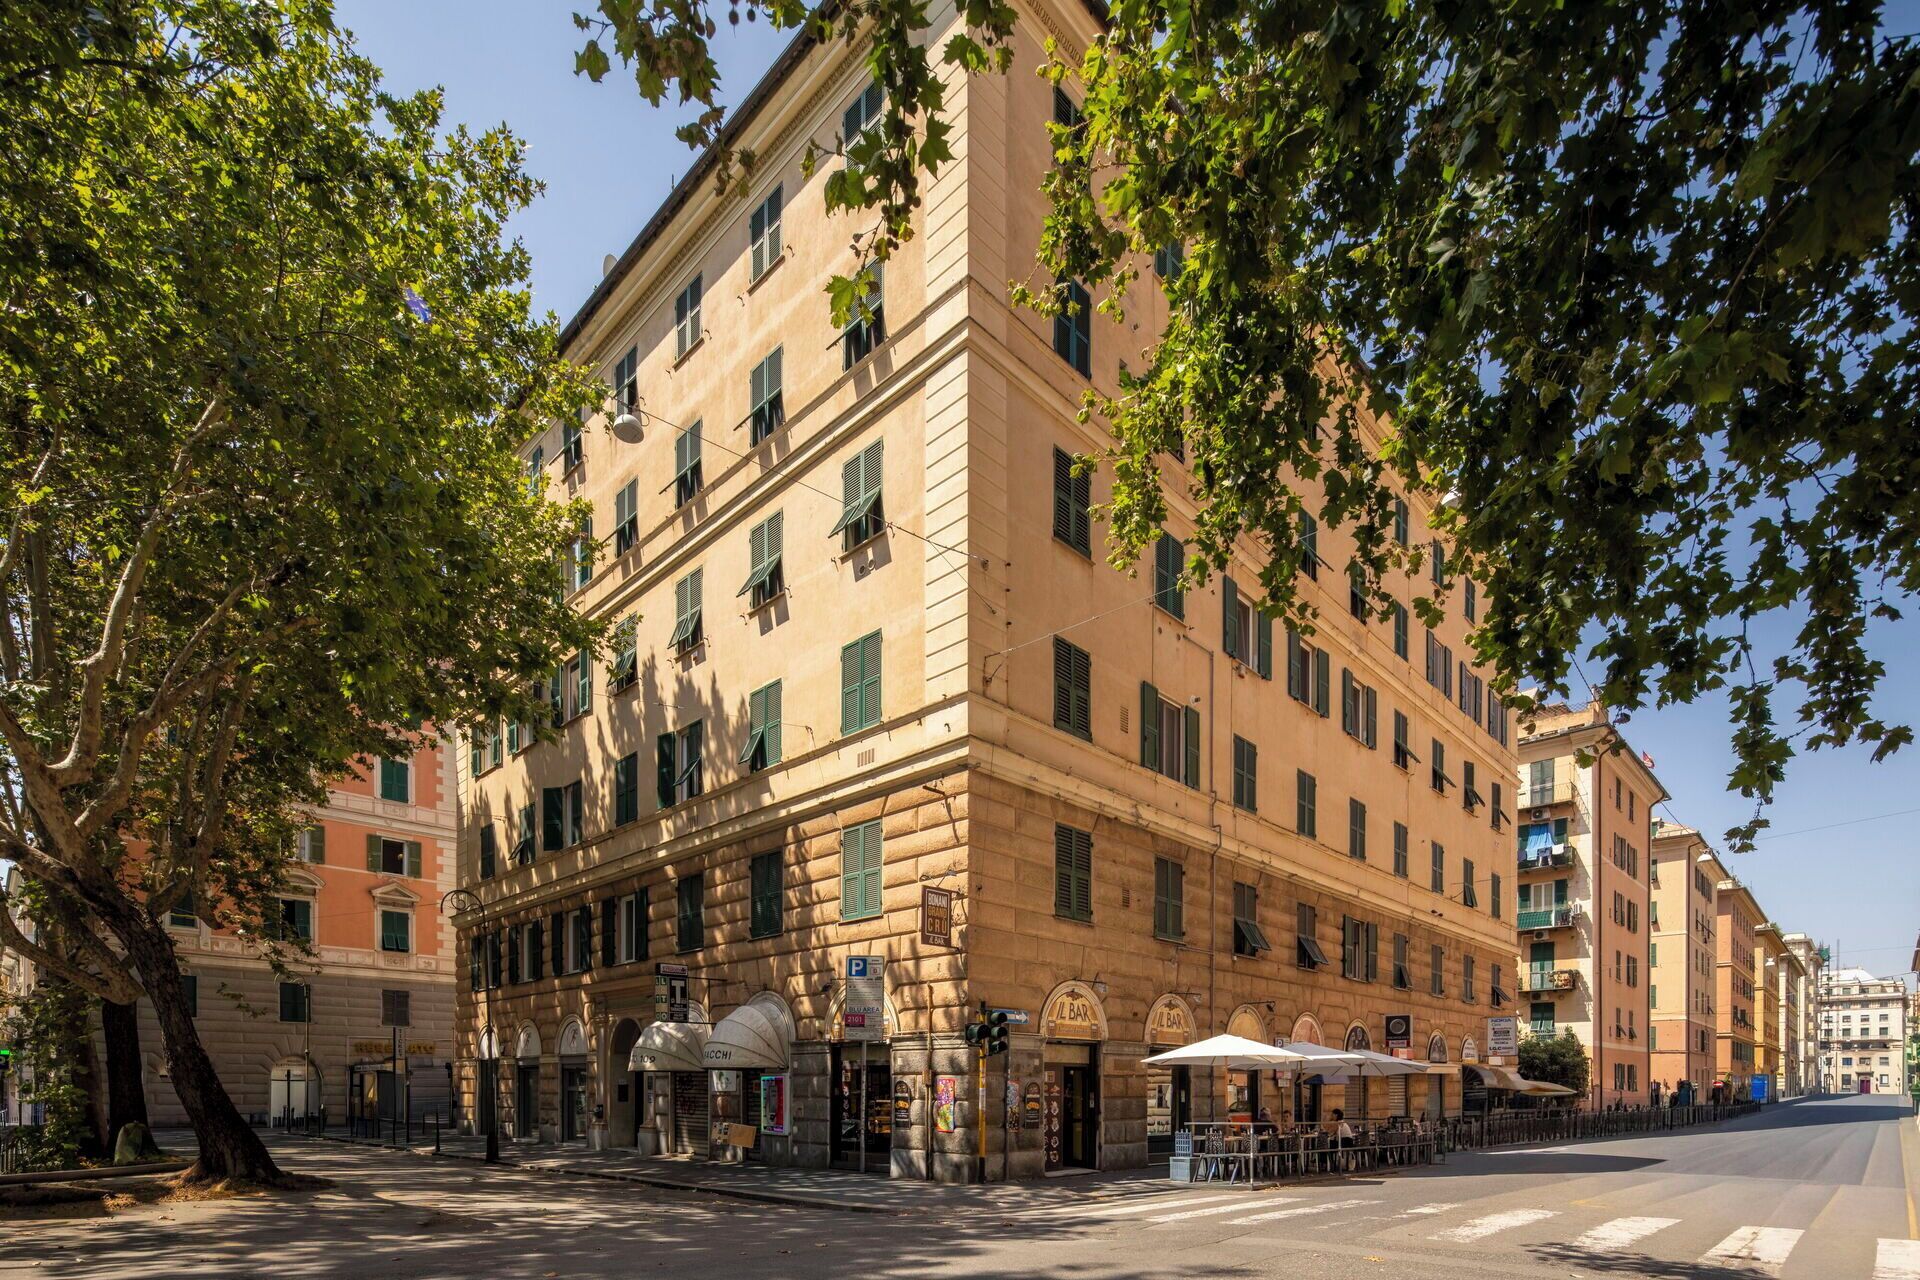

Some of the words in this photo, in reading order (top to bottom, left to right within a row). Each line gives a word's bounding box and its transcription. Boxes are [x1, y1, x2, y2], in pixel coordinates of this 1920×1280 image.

[927, 905, 948, 919] GRAND
[935, 936, 945, 945] BAR
[851, 959, 863, 976] P
[671, 979, 685, 1004] T
[863, 1006, 880, 1014] AREA
[1056, 1001, 1067, 1020] IL
[1068, 1002, 1091, 1022] BAR
[847, 1015, 862, 1023] 2101
[1156, 1011, 1165, 1027] IL
[1166, 1012, 1184, 1031] BAR
[640, 1055, 656, 1064] 109
